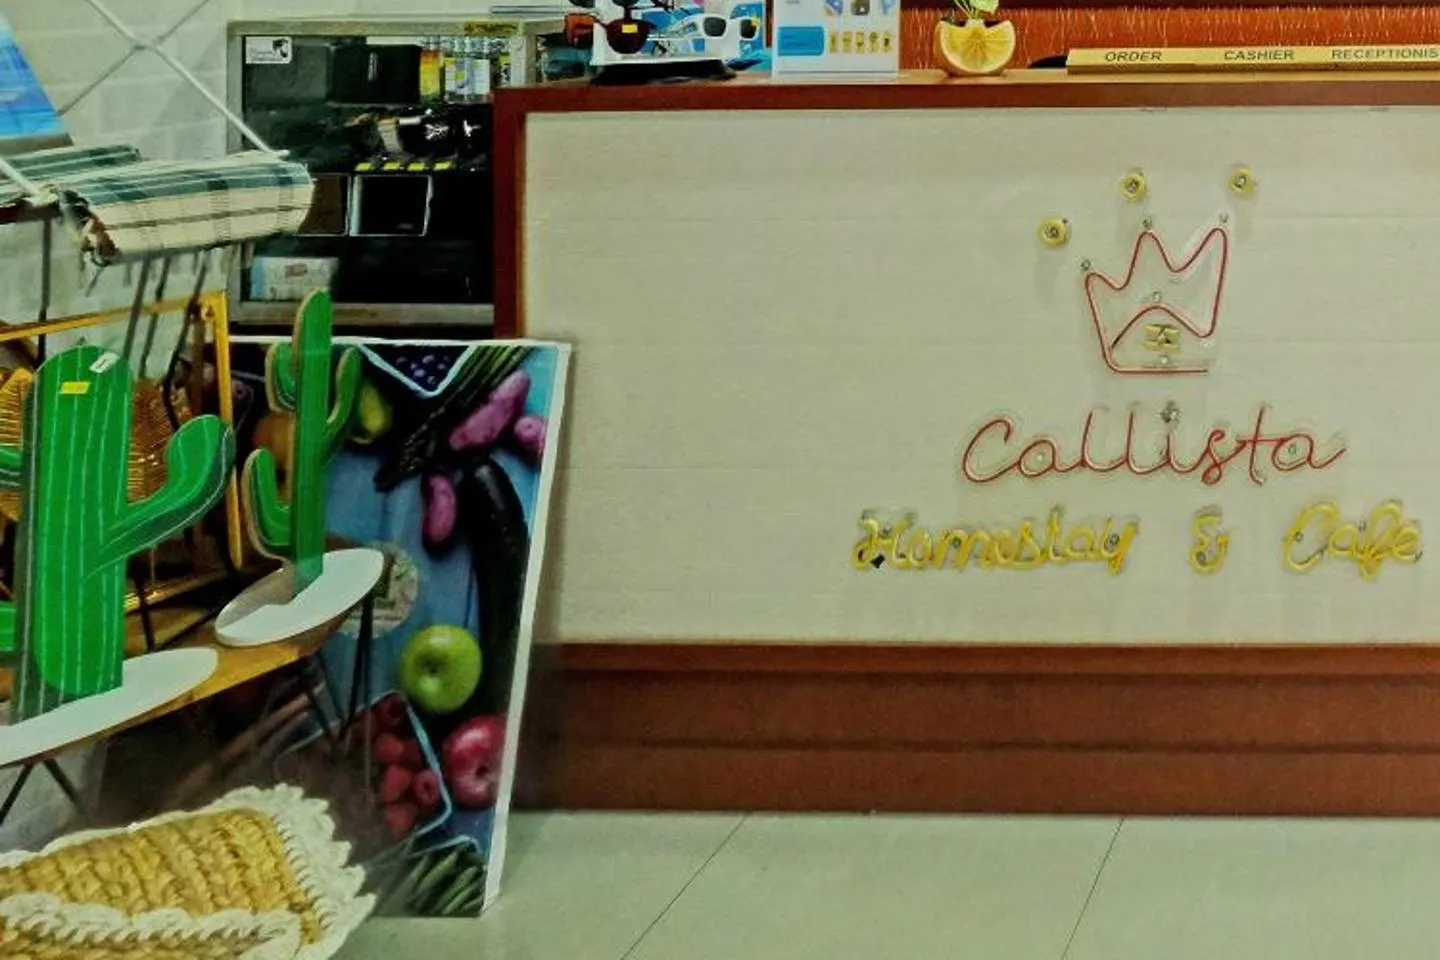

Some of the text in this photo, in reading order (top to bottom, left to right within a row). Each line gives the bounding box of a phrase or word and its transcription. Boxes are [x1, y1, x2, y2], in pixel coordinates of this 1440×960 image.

[1104, 50, 1163, 62] ORDER
[1223, 49, 1295, 62] CASHIER
[961, 405, 1347, 486] Callista
